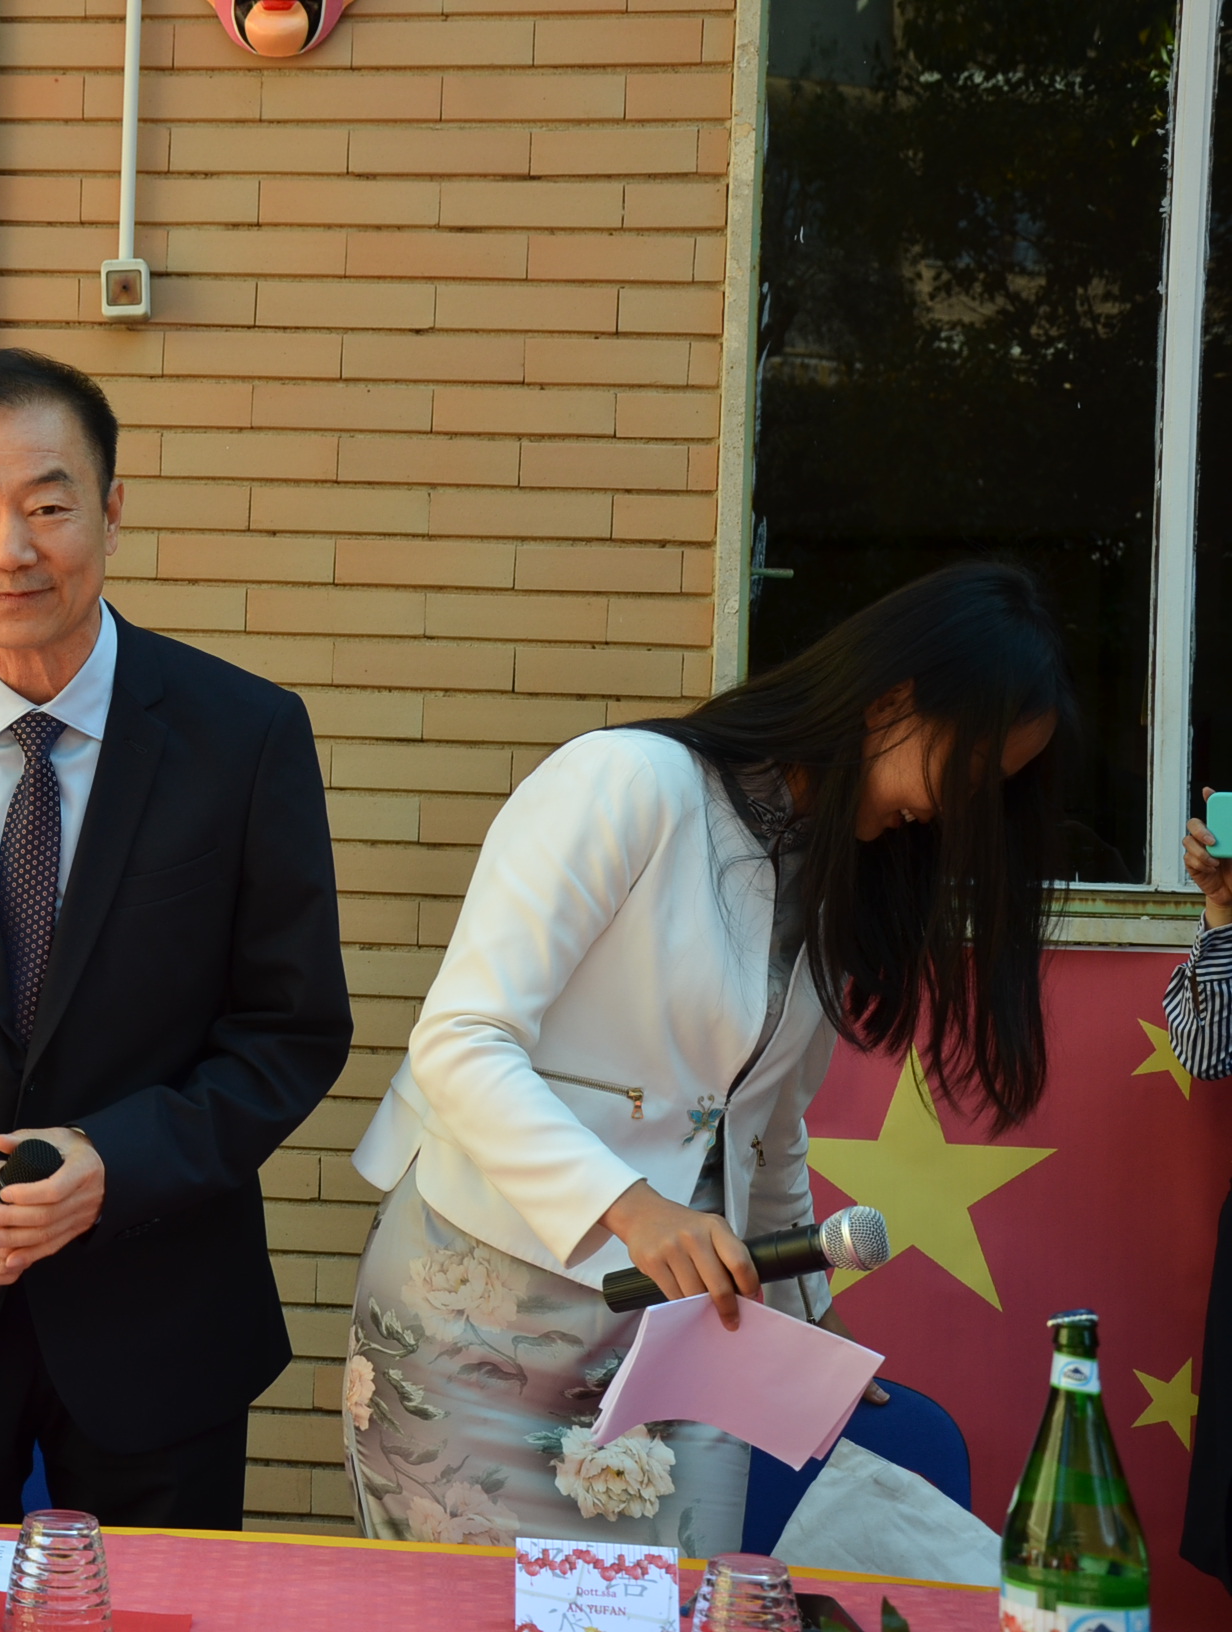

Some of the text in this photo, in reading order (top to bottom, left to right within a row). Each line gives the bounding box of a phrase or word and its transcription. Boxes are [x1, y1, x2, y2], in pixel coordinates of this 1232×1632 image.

[576, 1586, 617, 1598] Dott.ssa
[567, 1602, 627, 1616] AN YUFAN
